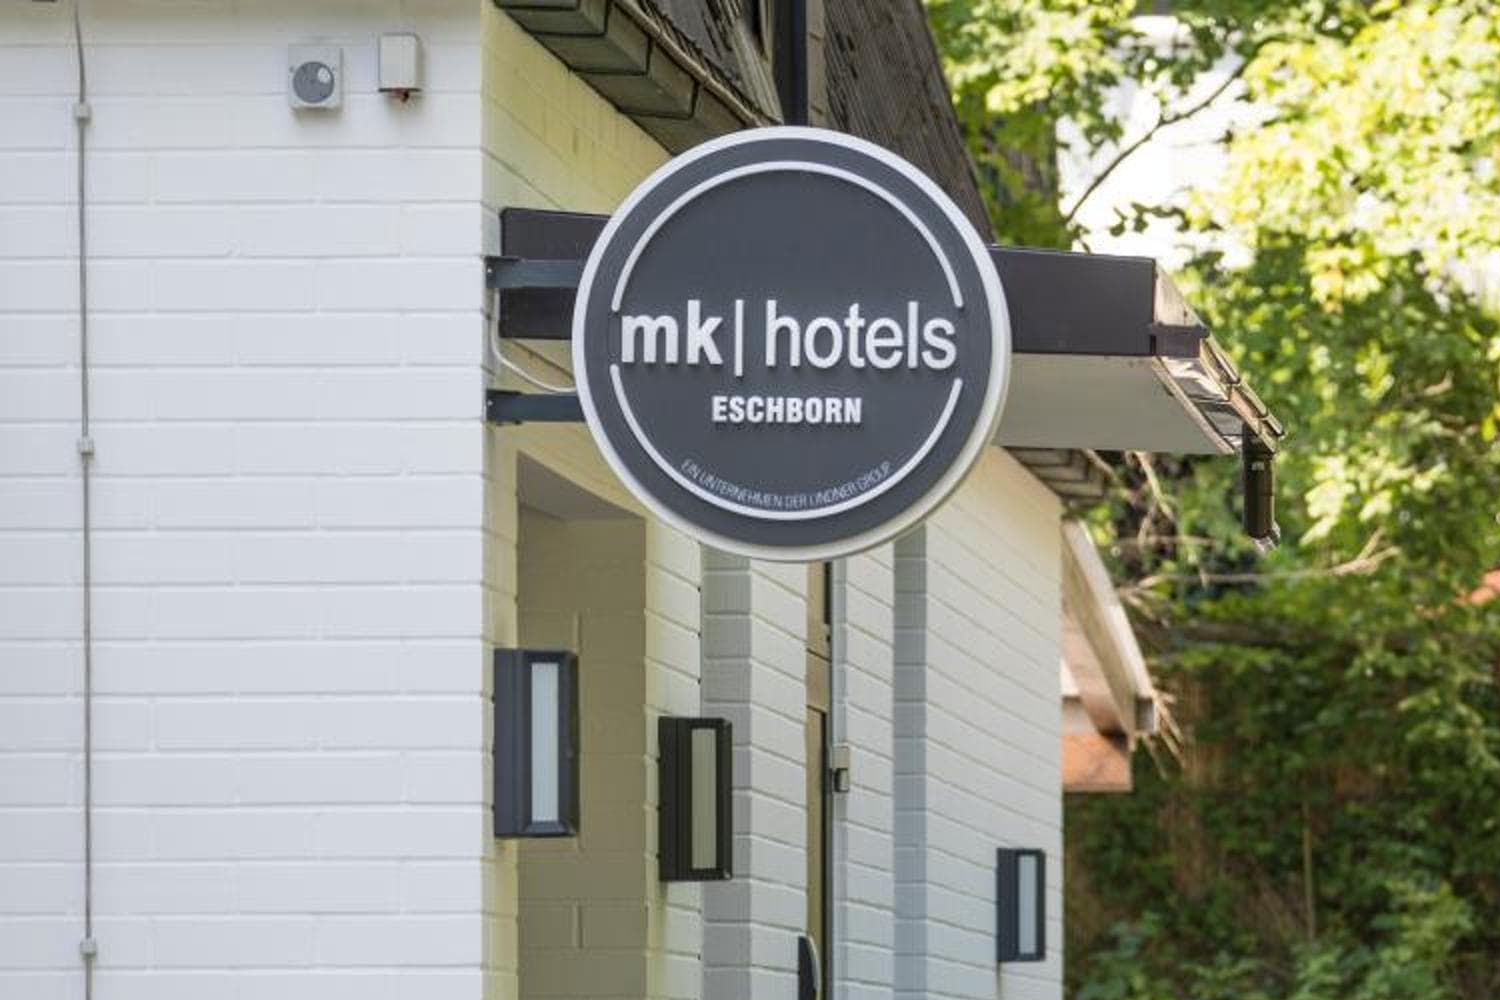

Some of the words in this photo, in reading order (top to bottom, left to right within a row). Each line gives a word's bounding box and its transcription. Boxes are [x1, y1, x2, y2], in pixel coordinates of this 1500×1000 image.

[711, 395, 863, 424] ESCHBORN
[681, 458, 699, 480] EIN
[698, 472, 784, 508] UNTERNEHMEN
[785, 494, 807, 510] DER
[809, 480, 857, 507] LINDNER
[856, 460, 892, 490] GROUP
